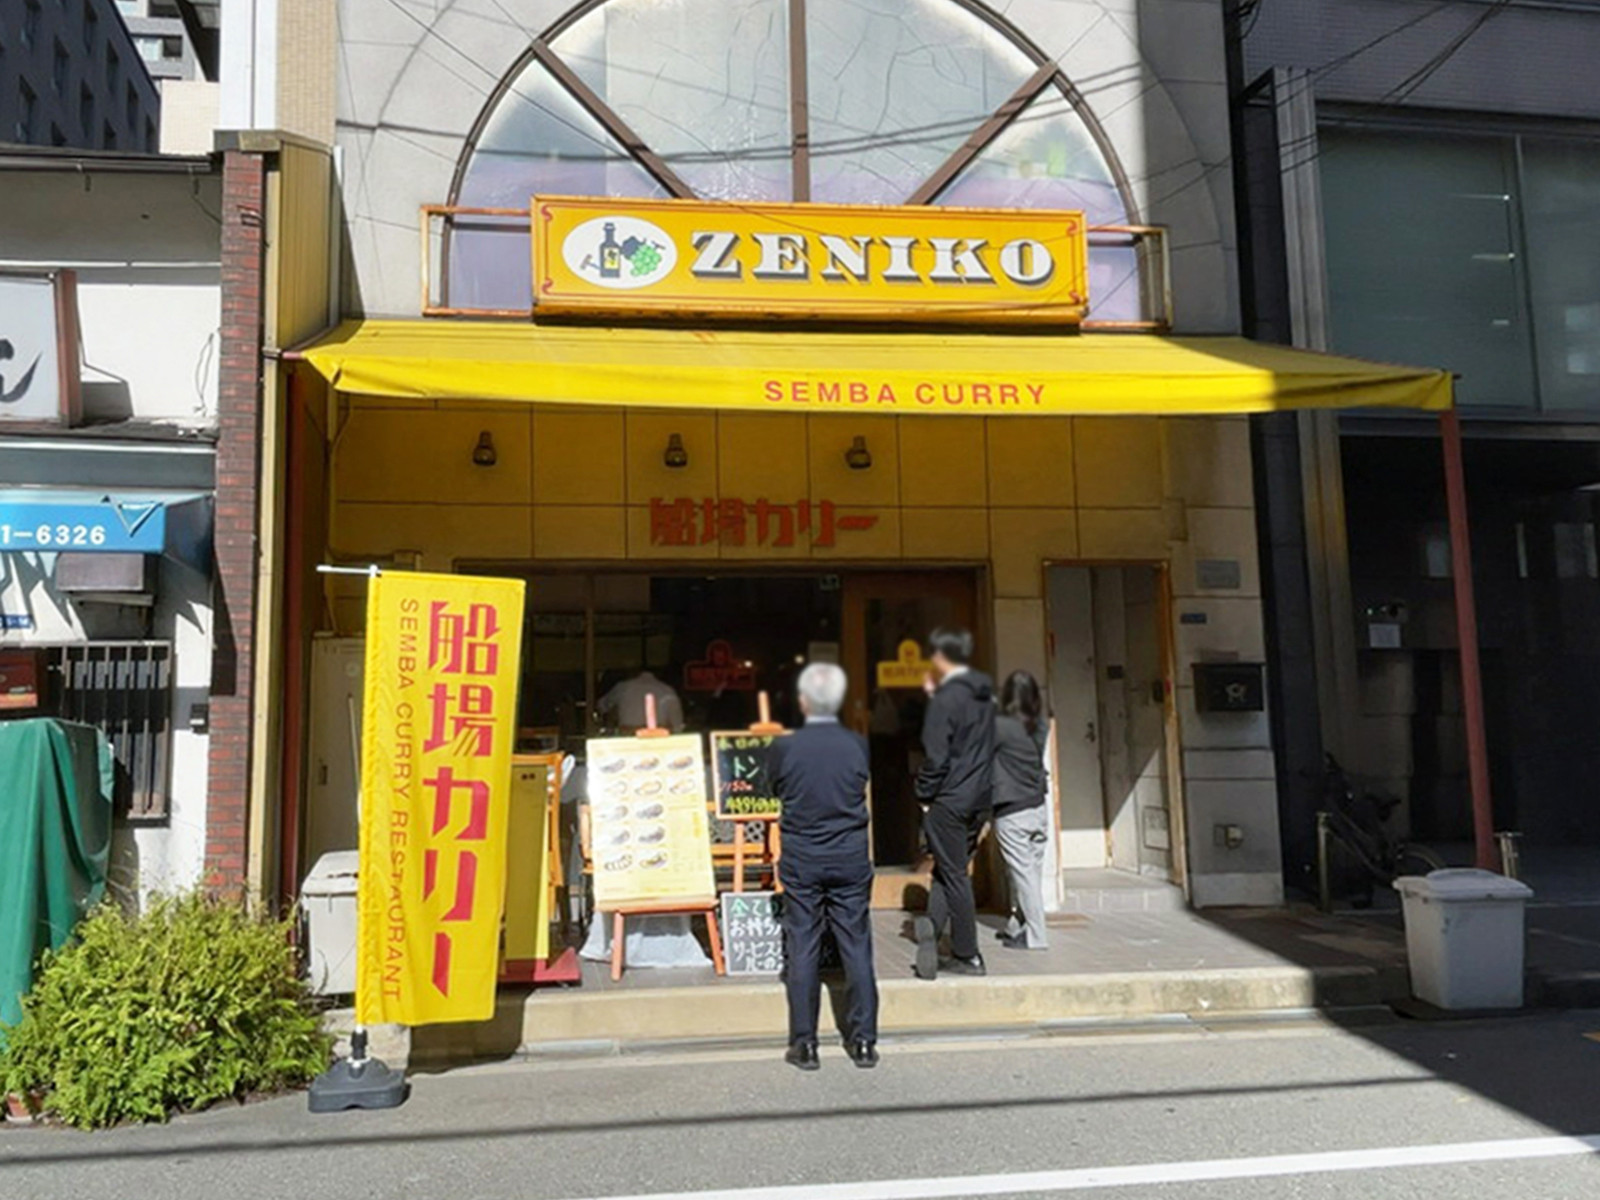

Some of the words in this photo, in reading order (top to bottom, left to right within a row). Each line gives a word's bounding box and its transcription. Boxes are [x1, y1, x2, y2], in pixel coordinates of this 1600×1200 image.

[690, 231, 1054, 284] ZENIKO
[764, 381, 897, 404] SEMBA
[915, 383, 1045, 405] CURRY
[650, 498, 878, 547] 船場カリー
[397, 598, 420, 691] SEMBA
[393, 702, 414, 800] CURRY
[421, 600, 502, 999] 船場カリー
[382, 810, 409, 1001] RESTAURANT
